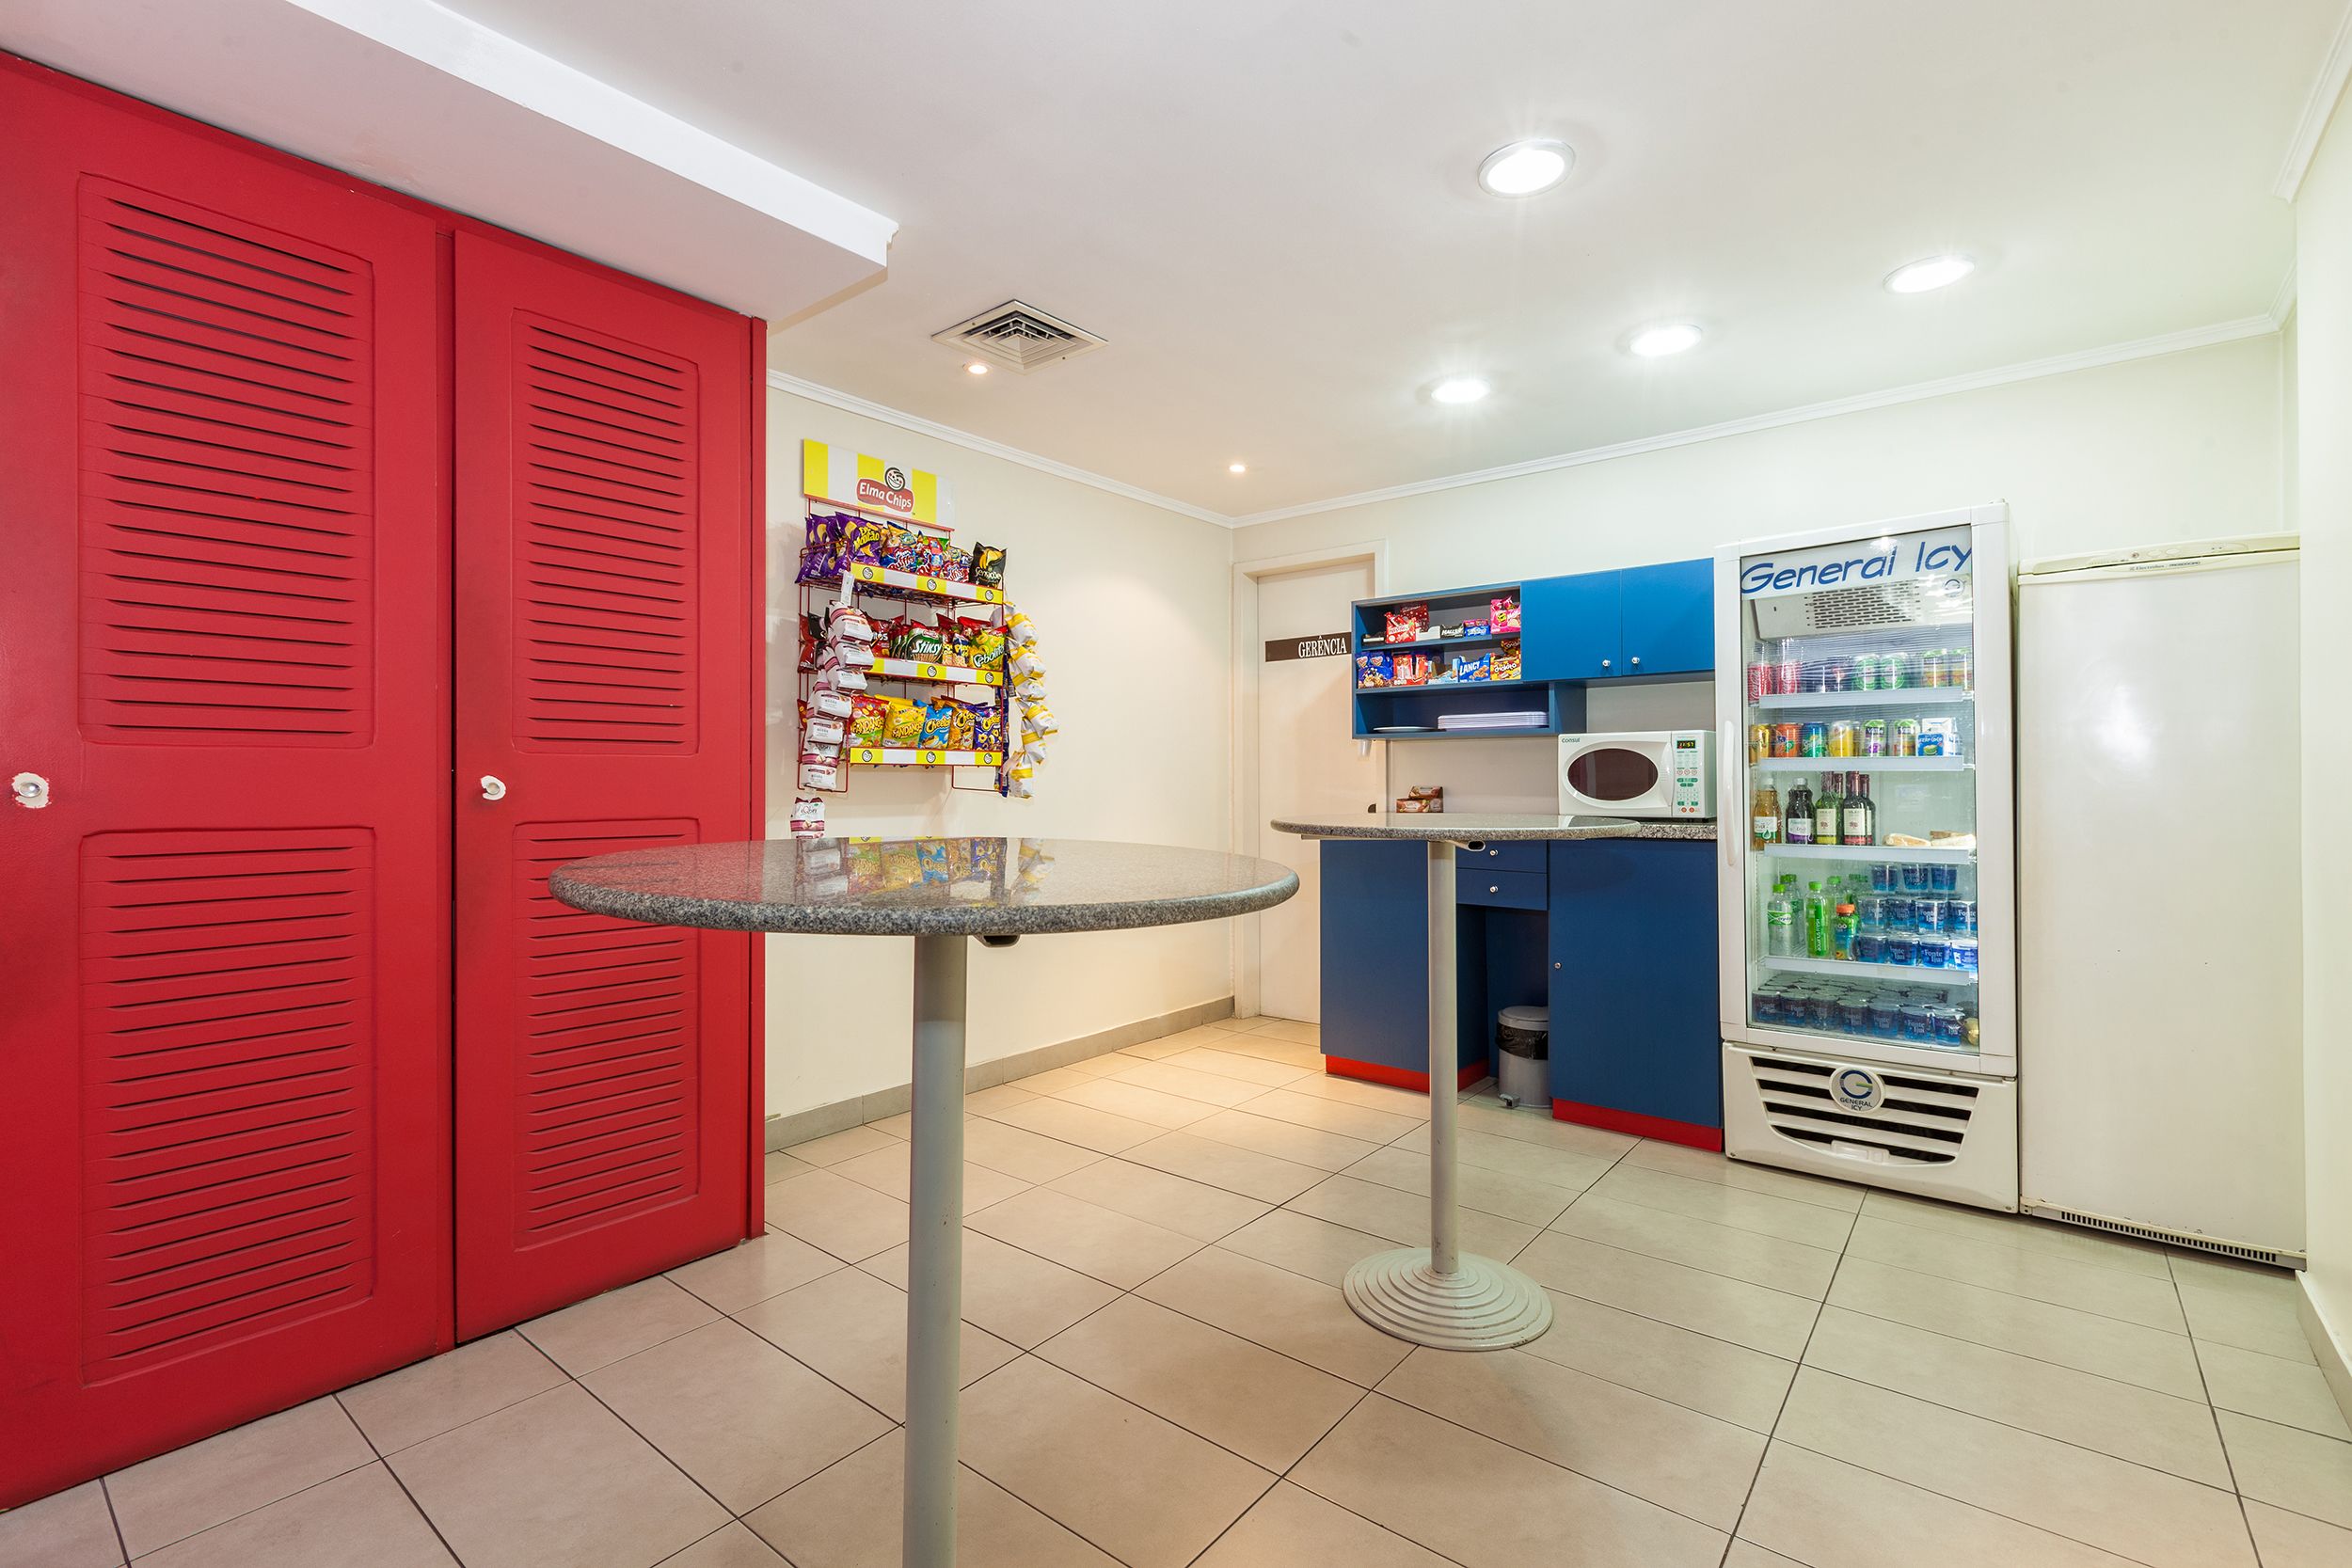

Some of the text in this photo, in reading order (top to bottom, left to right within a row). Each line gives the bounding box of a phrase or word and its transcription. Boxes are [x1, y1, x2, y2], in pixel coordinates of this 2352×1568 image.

[859, 482, 912, 510] Elma Chips
[1740, 541, 1972, 594] General Icy
[912, 640, 942, 656] Stiksy
[1298, 635, 1347, 658] GERÊNCIA
[1459, 660, 1480, 676] LANCY
[1840, 1098, 1873, 1108] GENERAL
